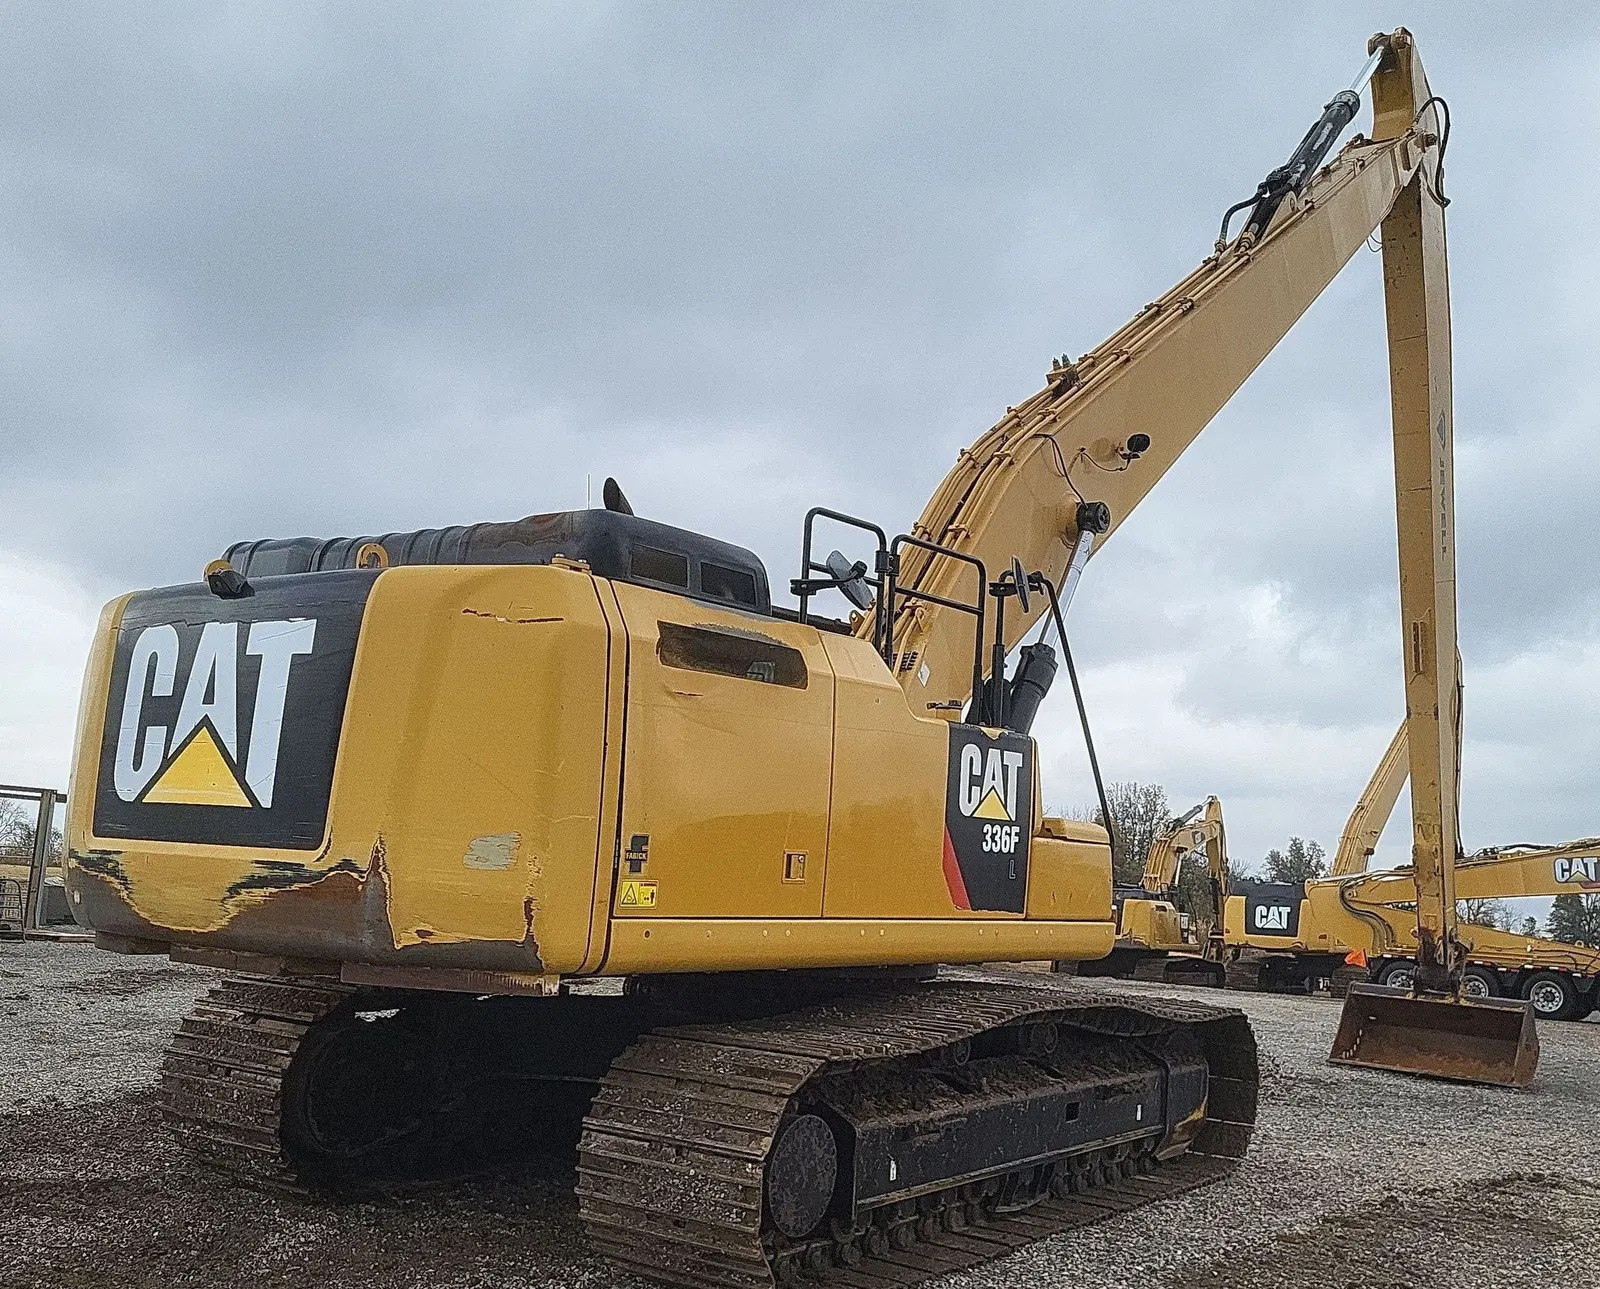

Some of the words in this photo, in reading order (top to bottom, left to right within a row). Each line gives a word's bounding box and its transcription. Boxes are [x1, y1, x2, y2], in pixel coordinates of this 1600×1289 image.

[114, 618, 318, 809] CAT
[959, 743, 1023, 822] CAT
[982, 824, 1020, 853] 336F
[625, 852, 647, 860] FABICK
[1008, 859, 1016, 880] L
[1554, 857, 1598, 883] CAT
[1254, 905, 1292, 930] CAT
